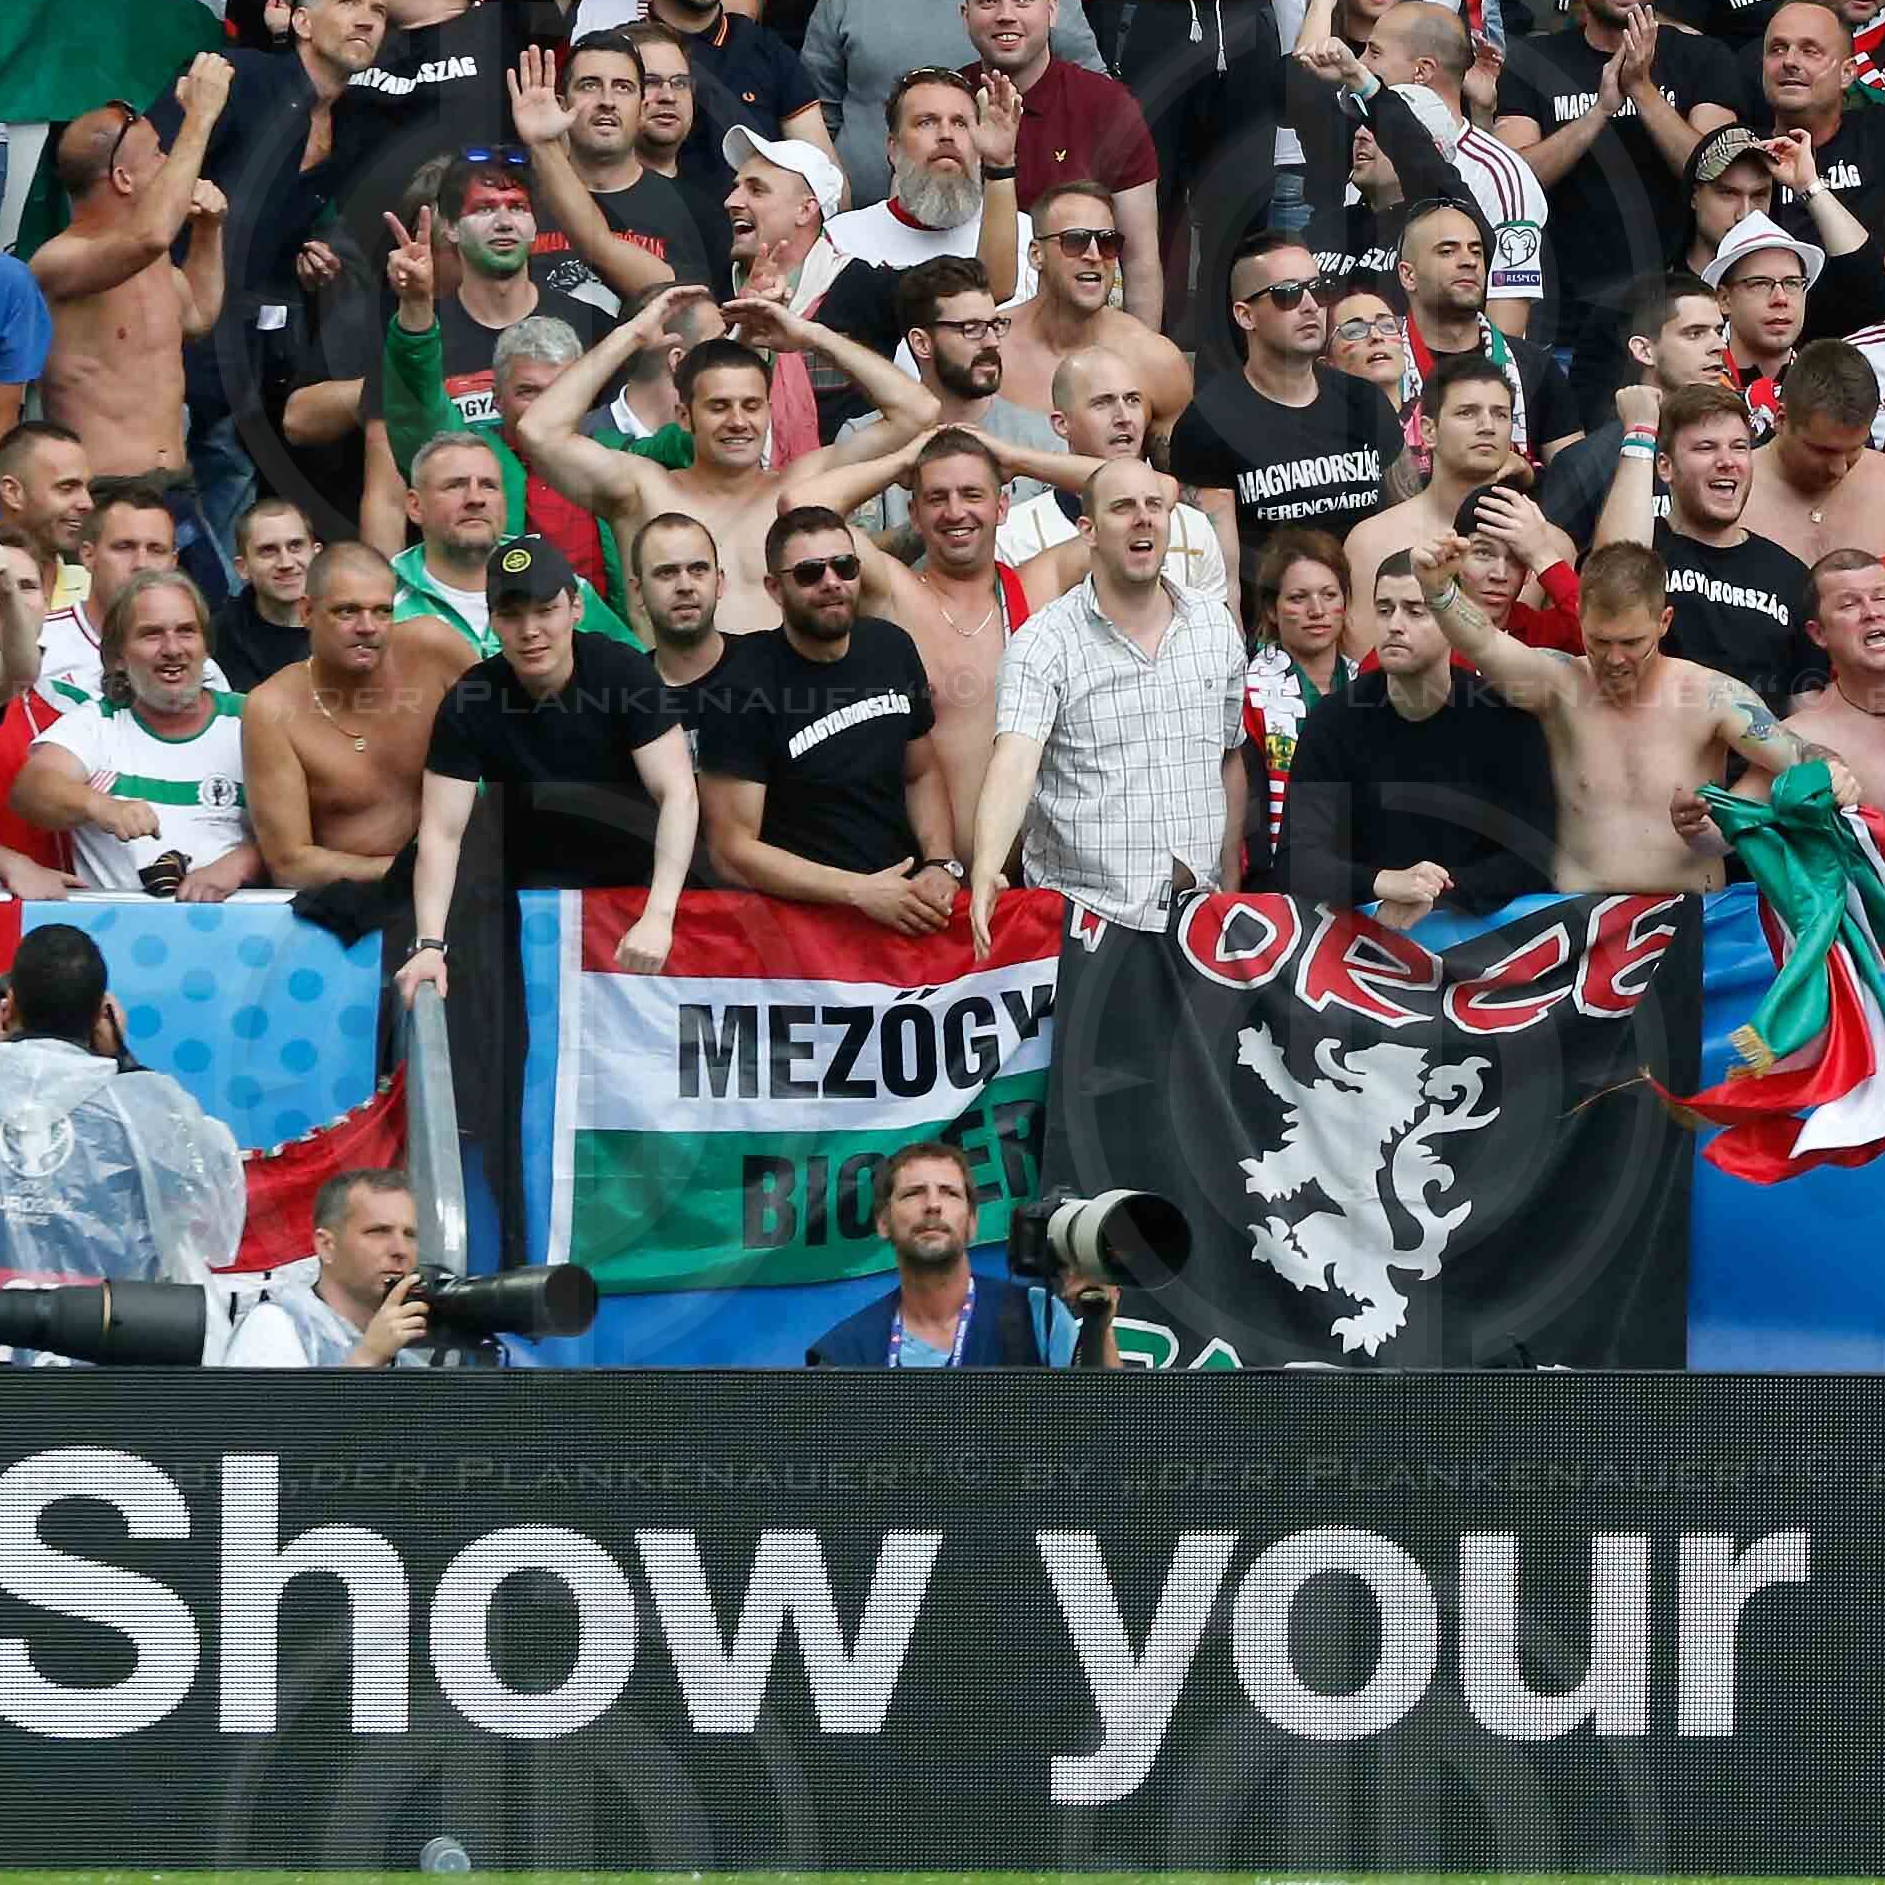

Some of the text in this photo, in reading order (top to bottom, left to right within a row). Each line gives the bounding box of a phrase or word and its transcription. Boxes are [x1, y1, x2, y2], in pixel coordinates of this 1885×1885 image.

[1506, 270, 1540, 283] RESPECT
[1256, 488, 1380, 520] FERENCVÁROS
[1665, 569, 1789, 626] AGYARORSZÁG
[1038, 1528, 1813, 1805] your
